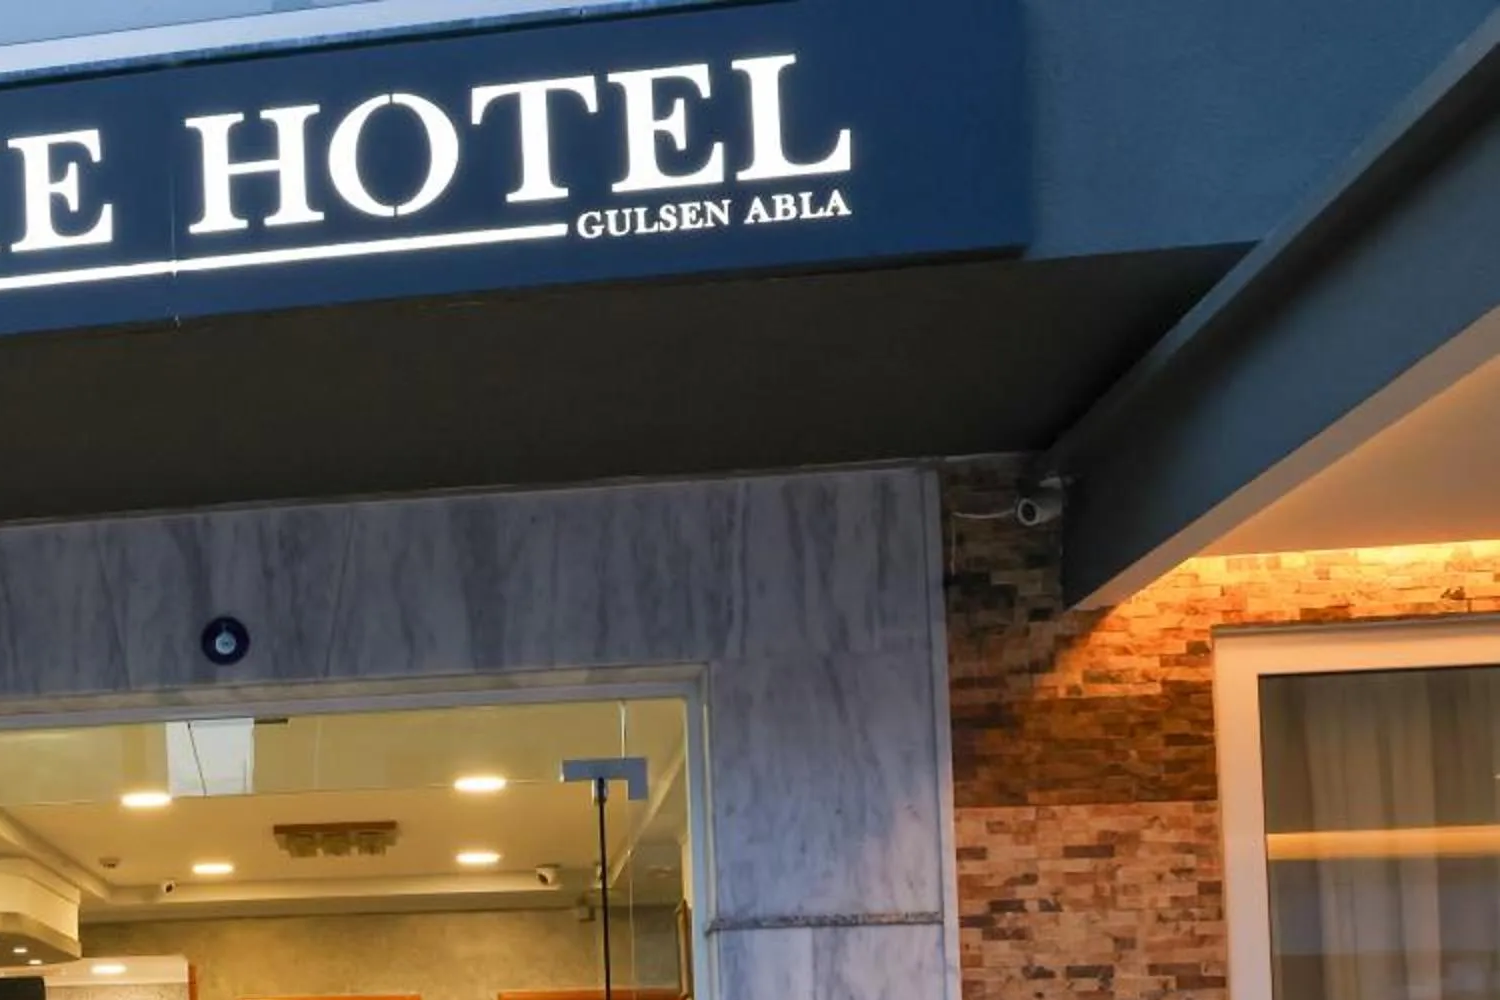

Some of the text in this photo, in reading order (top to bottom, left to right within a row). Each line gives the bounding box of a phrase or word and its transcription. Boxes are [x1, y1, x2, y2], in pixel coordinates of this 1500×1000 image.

[185, 53, 852, 235] HOTEL
[577, 189, 852, 239] GULSEN ABLA
